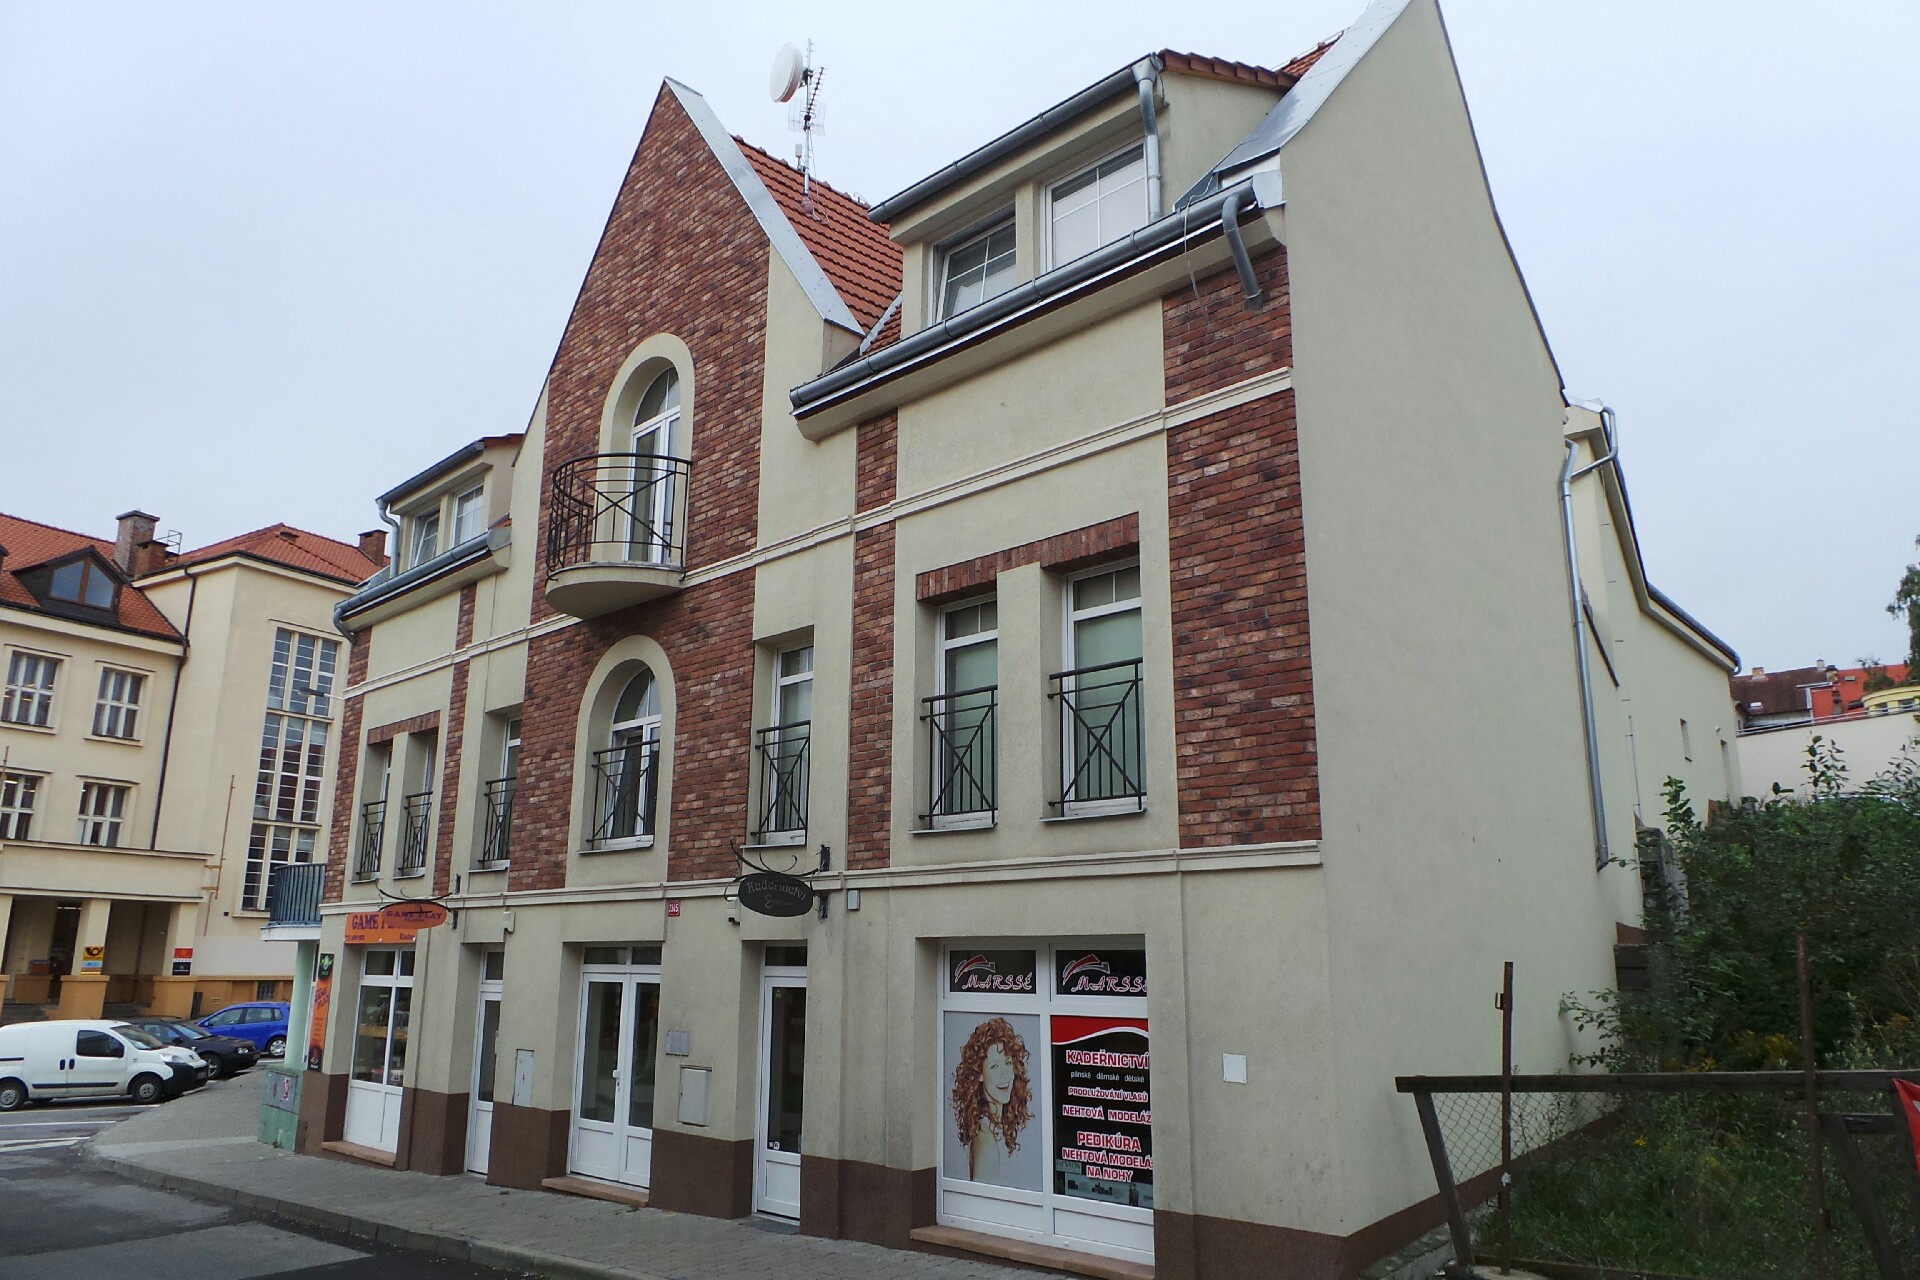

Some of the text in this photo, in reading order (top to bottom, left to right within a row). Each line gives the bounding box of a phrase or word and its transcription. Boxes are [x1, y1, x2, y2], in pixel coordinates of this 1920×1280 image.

[352, 914, 379, 930] GAME
[386, 910, 415, 918] GAME
[1066, 1049, 1149, 1069] KADEŘNICTVÍ
[1070, 1070, 1092, 1079] pánské
[1096, 1072, 1120, 1081] dámské
[1068, 1086, 1123, 1101] PRODLUŽOVÁNÍ
[1062, 1104, 1105, 1120] NEHTOVÁ
[1077, 1131, 1142, 1152] PEDIKÚRA
[1062, 1148, 1153, 1170] NEHTOVÁ MODELÁ
[1086, 1165, 1134, 1182] NA NOHY
